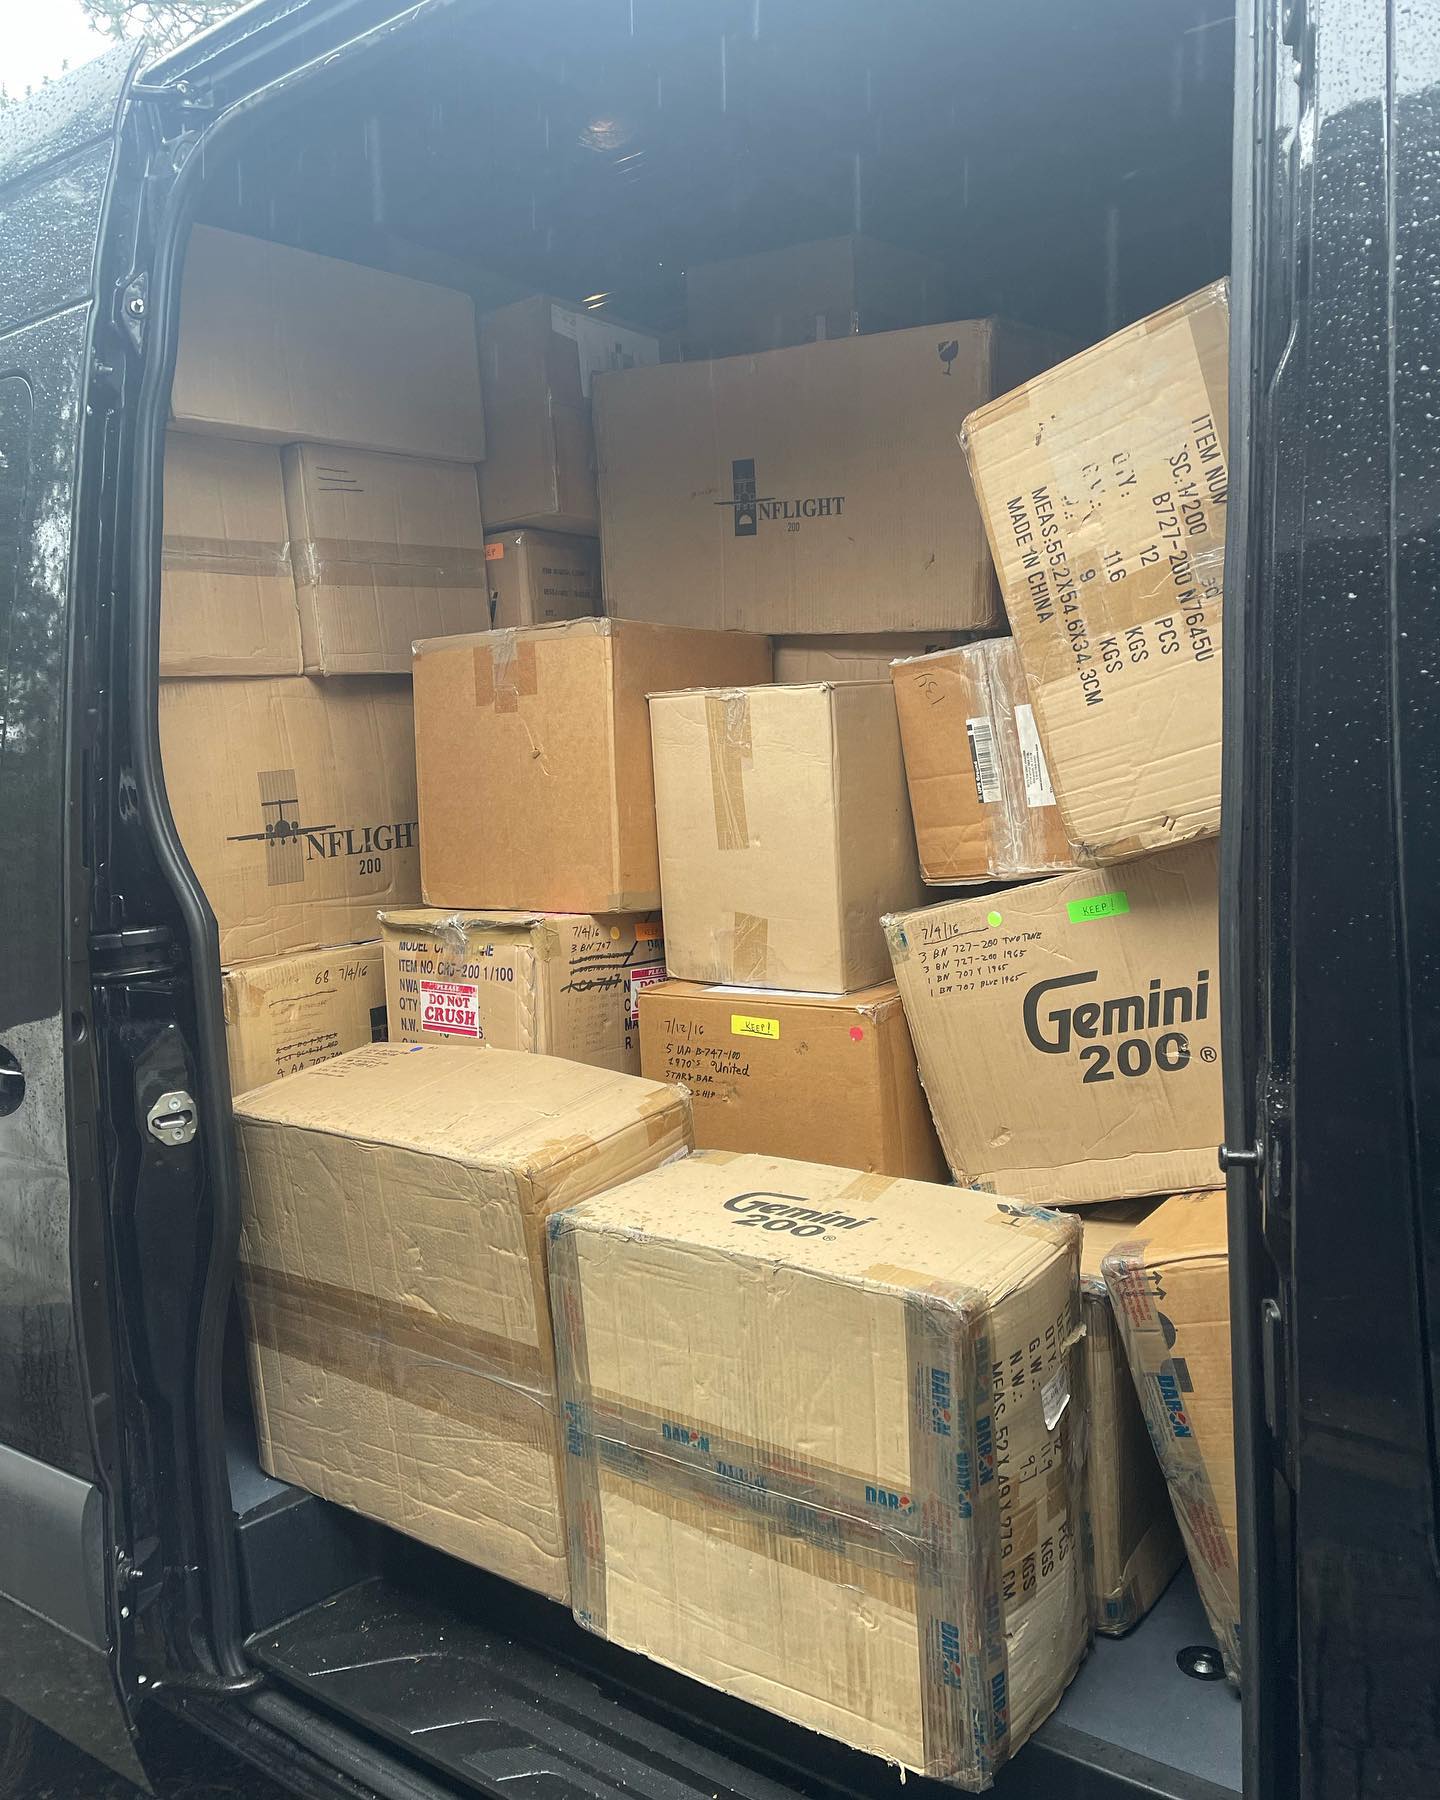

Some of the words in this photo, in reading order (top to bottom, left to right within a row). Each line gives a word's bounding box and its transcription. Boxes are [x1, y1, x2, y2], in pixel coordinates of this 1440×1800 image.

[1192, 414, 1221, 464] ITEM
[787, 522, 800, 532] 200
[1006, 496, 1033, 546] MADE
[1027, 572, 1054, 624] CHINA
[1104, 550, 1126, 582] 11.6
[1125, 626, 1149, 663] KGS
[1140, 544, 1159, 567] 12
[1154, 616, 1180, 655] PCS
[1099, 636, 1124, 674] KGS
[360, 858, 381, 876] 200
[922, 922, 959, 940] 7/4/16
[918, 952, 927, 963] 3
[933, 946, 948, 960] BN
[952, 938, 998, 954] 727-200
[923, 966, 930, 974] 3
[936, 960, 950, 970] BN
[954, 953, 997, 967] 727-200
[1003, 950, 1028, 958] 1965
[314, 970, 329, 984] 68
[339, 962, 368, 982] 7/4/16
[399, 960, 418, 973] ITEM
[420, 960, 435, 974] NO.
[937, 973, 950, 982] BN
[956, 968, 974, 977] 707
[987, 964, 1008, 973] 1965
[436, 982, 460, 991] PLEASE
[956, 982, 974, 991] 707
[429, 994, 444, 1006] DO
[447, 996, 470, 1008] NOT
[1022, 969, 1210, 1054] Gemini
[424, 1006, 476, 1026] CRUSH
[664, 1018, 704, 1040] 7/12/16
[666, 1044, 674, 1054] 5
[1079, 1032, 1191, 1084] 200
[710, 1060, 750, 1077] United
[723, 1192, 879, 1230] Gemini
[731, 1214, 826, 1238] 200
[1158, 1375, 1192, 1438] DARON
[976, 1416, 994, 1486] DARON
[1040, 1536, 1054, 1577] KGS
[1022, 1552, 1036, 1591] KGS
[941, 1620, 962, 1690] DARON
